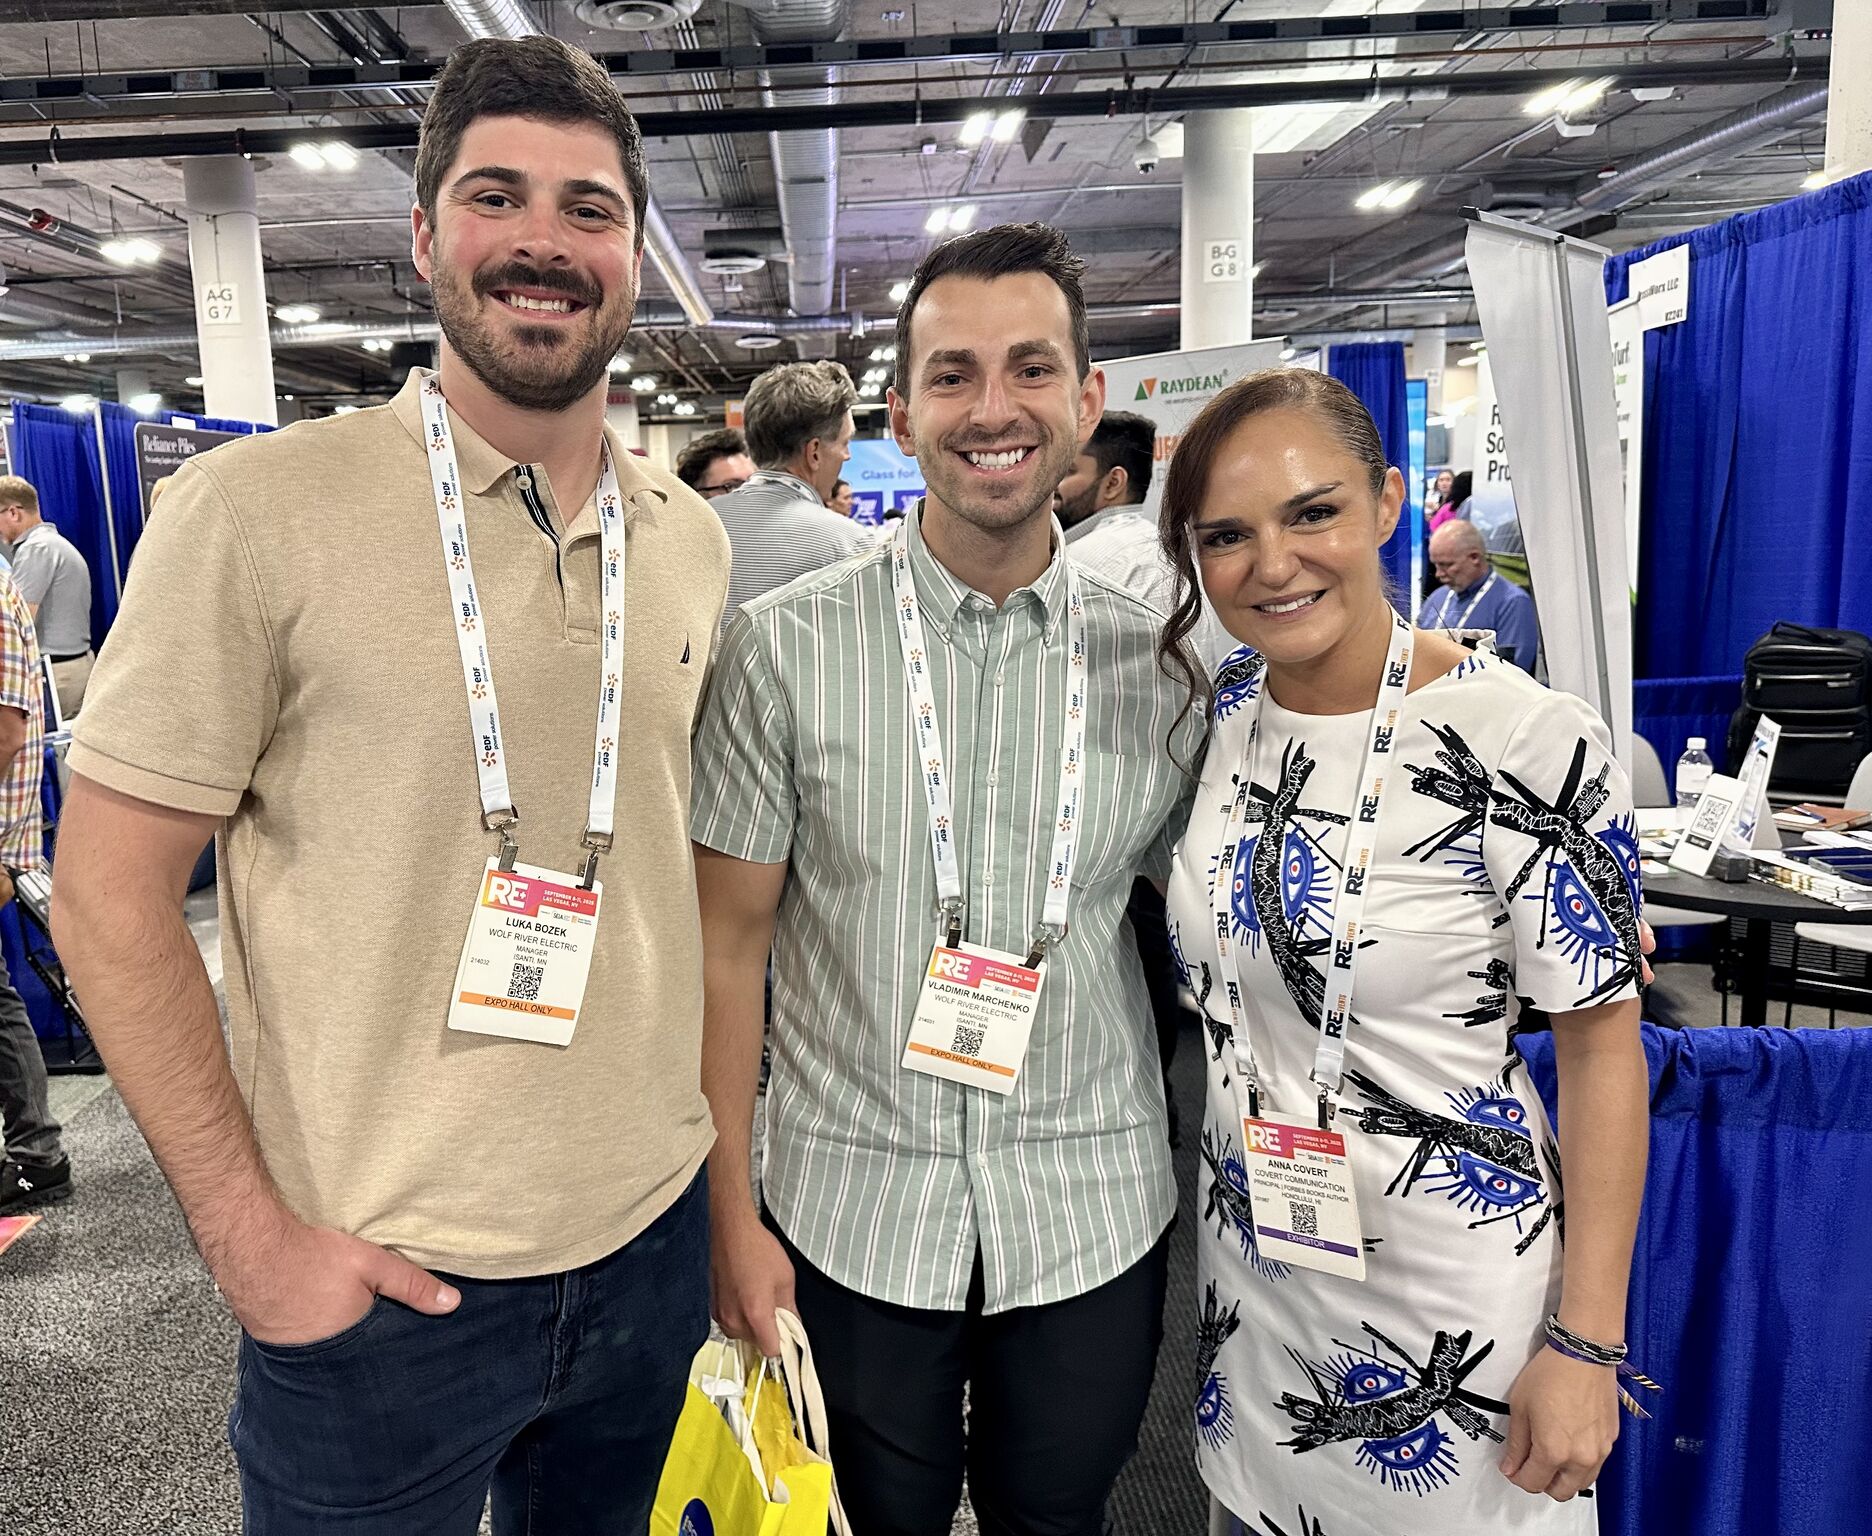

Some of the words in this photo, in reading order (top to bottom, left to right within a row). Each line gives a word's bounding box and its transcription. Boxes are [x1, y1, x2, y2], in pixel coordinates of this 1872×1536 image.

[1212, 245, 1236, 259] B-G
[1211, 263, 1223, 277] G
[1228, 263, 1237, 276] 8
[1667, 277, 1679, 291] LLC
[207, 288, 232, 301] A-G
[208, 306, 219, 319] G
[224, 306, 232, 318] 7
[861, 469, 895, 480] Glass
[898, 468, 916, 480] for
[1359, 848, 1369, 867] EVENTS
[544, 889, 572, 900] SEPTEMBER
[506, 917, 532, 931] LUKA
[534, 920, 568, 938] BOZEK
[1346, 921, 1357, 941] EVENTS
[489, 928, 512, 940] WOLF
[514, 932, 539, 945] RIVER
[540, 937, 578, 953] ELECTRIC
[516, 945, 548, 957] MANAGER
[513, 954, 536, 965] ISANTI,
[536, 957, 548, 966] MN
[484, 996, 508, 1008] EXPO
[509, 1000, 530, 1012] HALL
[530, 1003, 553, 1015] ONLY
[928, 980, 971, 998] VLADIMIR
[971, 992, 1030, 1014] MARCHENKO
[1337, 993, 1347, 1013] EVENTS
[934, 993, 956, 1005] WOLF
[957, 1000, 980, 1012] RIVER
[981, 1005, 1018, 1022] ELECTRIC
[958, 1010, 989, 1023] MANAGER
[978, 1022, 988, 1030] MN
[930, 1048, 951, 1060] EXPO
[952, 1054, 971, 1065] HALL
[972, 1060, 994, 1070] ONLY
[1268, 1159, 1292, 1170] ANNA
[1293, 1163, 1328, 1178] COVERT
[1255, 1168, 1284, 1180] COVERT
[1284, 1173, 1346, 1193] COMMUNICATION
[1254, 1178, 1281, 1190] PRINCIPAL
[1283, 1184, 1306, 1195] FORBES
[1306, 1188, 1325, 1198] BOOKS
[1326, 1192, 1349, 1203] AUTHOR
[1287, 1233, 1326, 1249] EXHIBITOR
